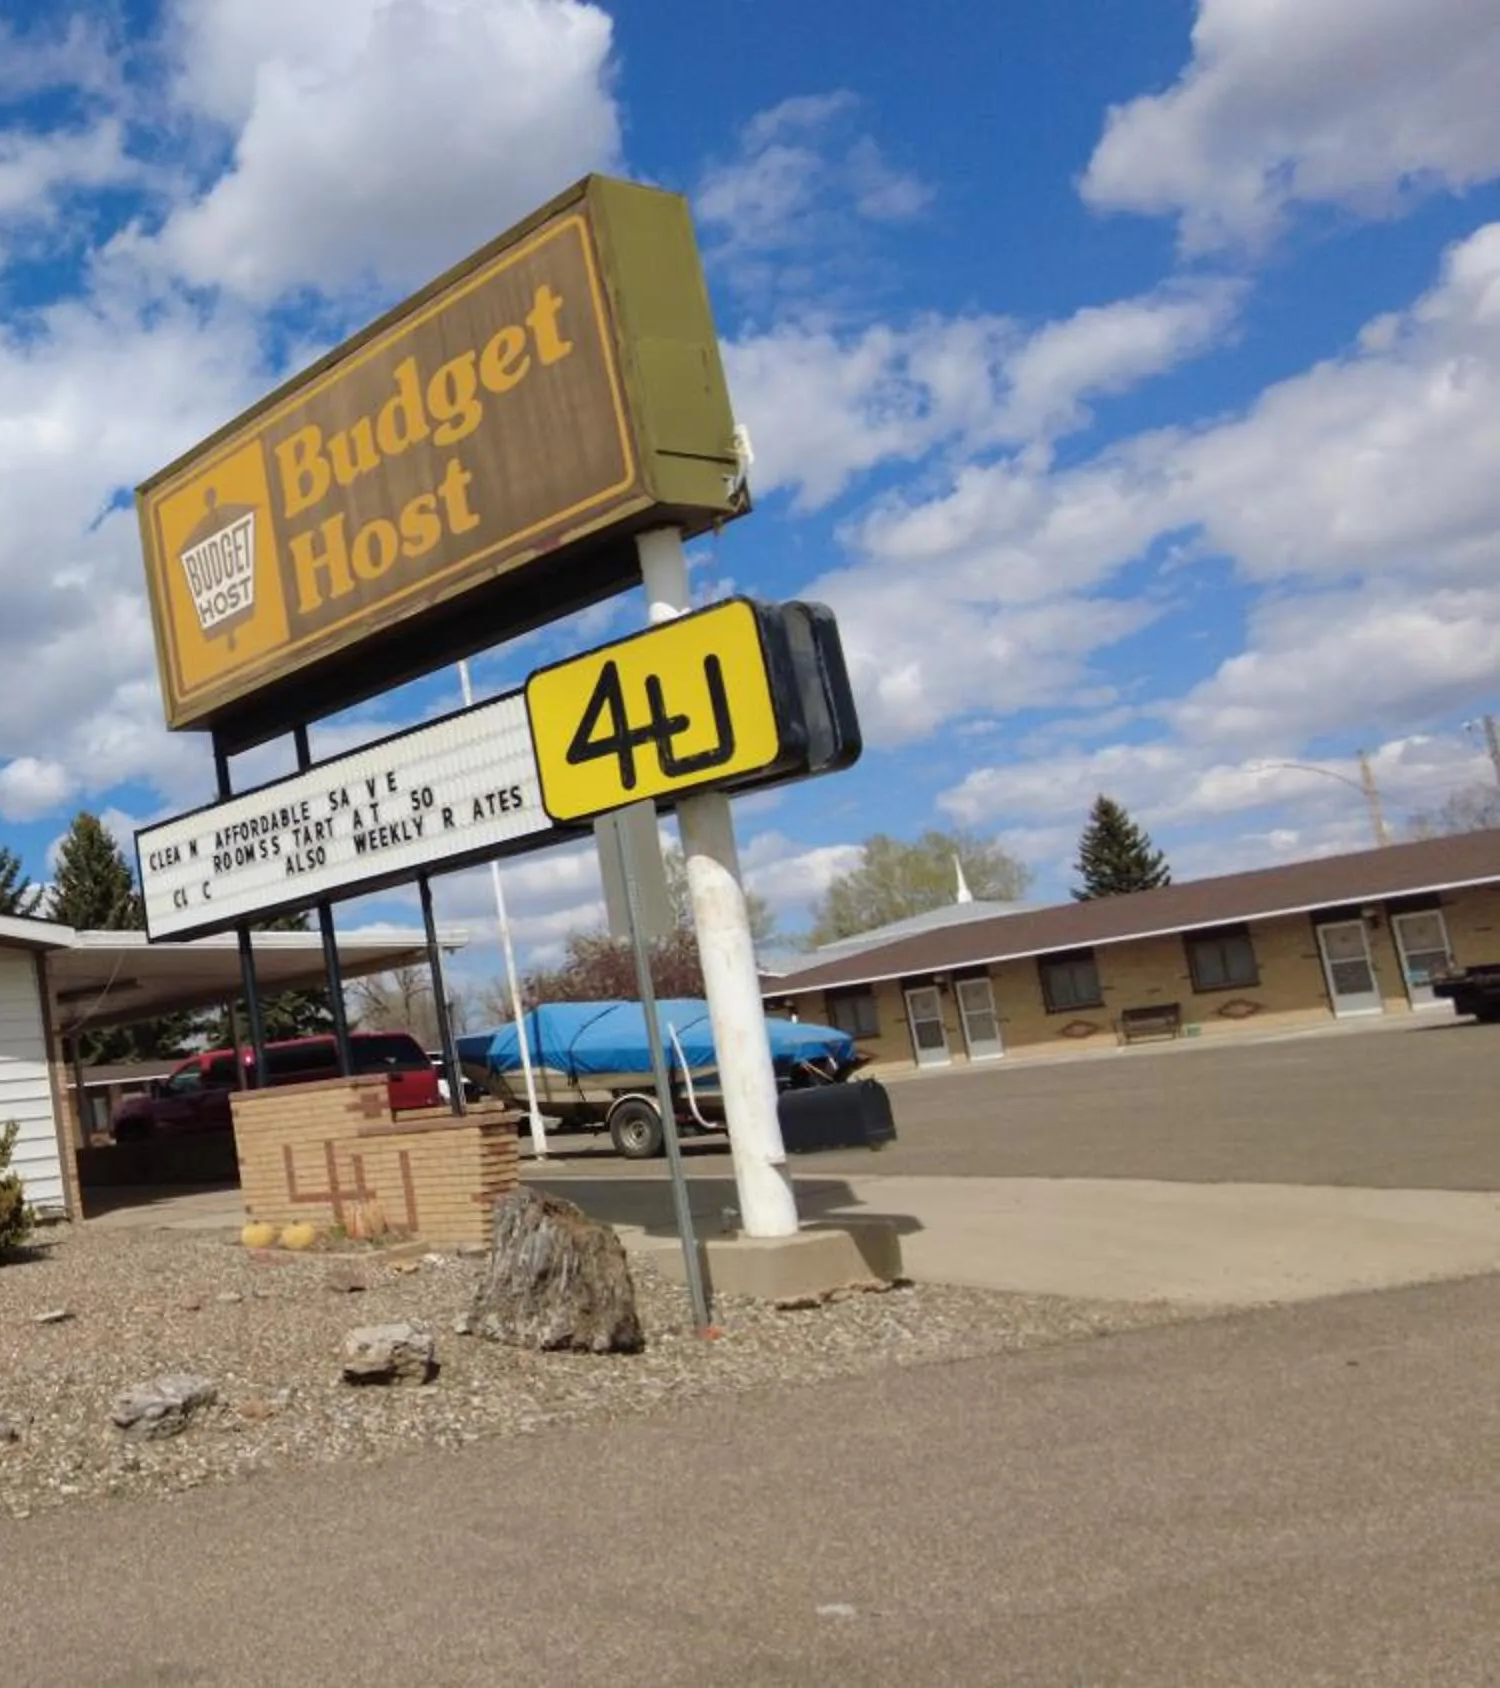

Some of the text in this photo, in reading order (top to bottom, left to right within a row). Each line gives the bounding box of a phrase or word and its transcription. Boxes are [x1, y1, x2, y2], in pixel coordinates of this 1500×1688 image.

[274, 285, 573, 518] Budget
[185, 518, 252, 597] BUDGET
[288, 458, 480, 615] Host
[200, 576, 251, 624] HOST
[215, 801, 311, 849] AFFORDABLE
[411, 787, 434, 811] 50
[286, 846, 326, 876] ALSO
[353, 816, 424, 854] WEEKLY
